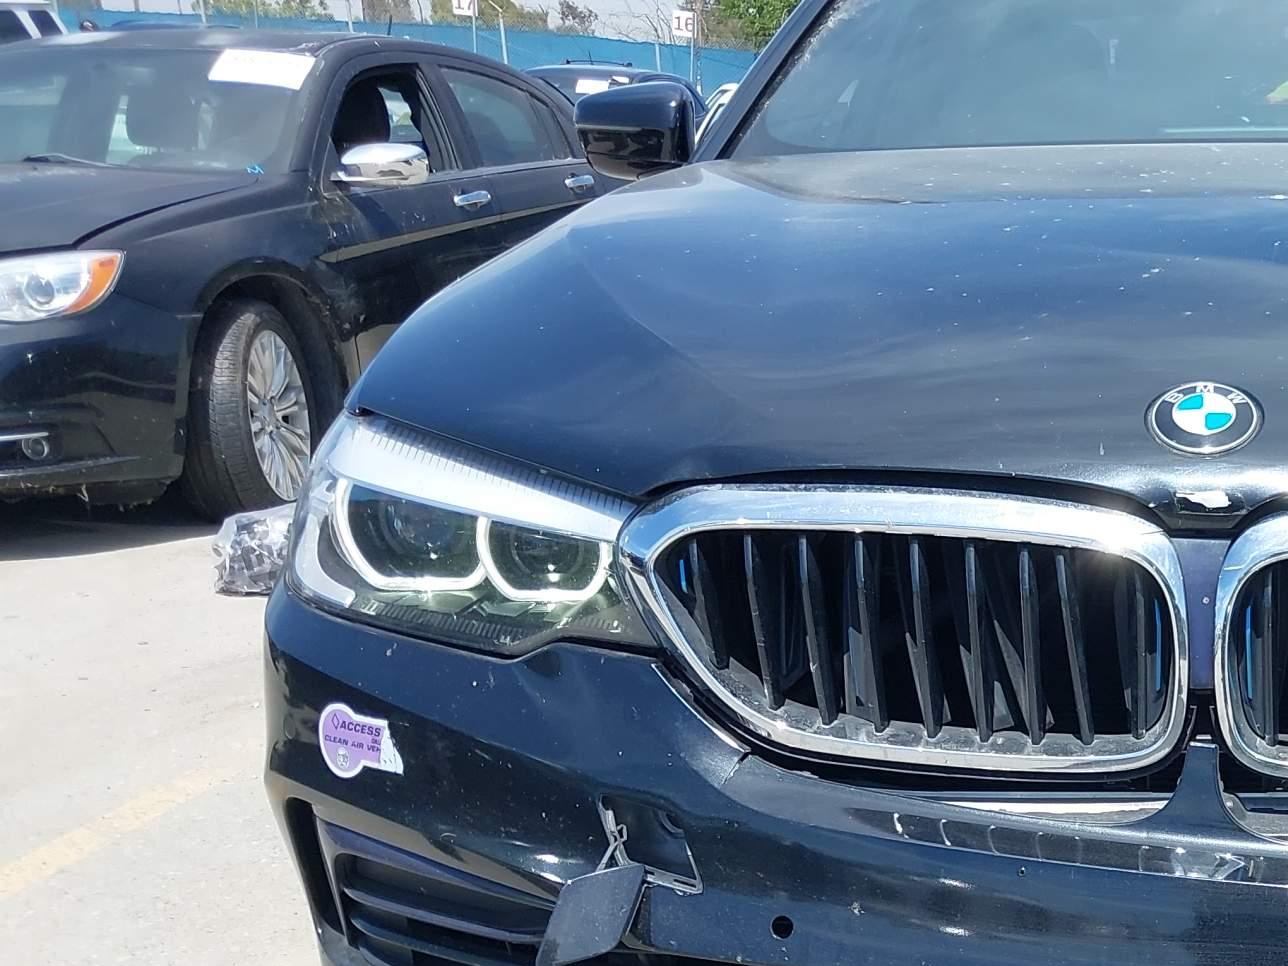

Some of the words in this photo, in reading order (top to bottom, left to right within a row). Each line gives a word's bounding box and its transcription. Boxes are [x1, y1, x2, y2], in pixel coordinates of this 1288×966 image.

[674, 16, 693, 32] 16
[1164, 383, 1249, 405] BMW
[340, 720, 381, 737] ACCESS
[324, 734, 349, 746] CLEAN
[351, 740, 364, 750] AIR
